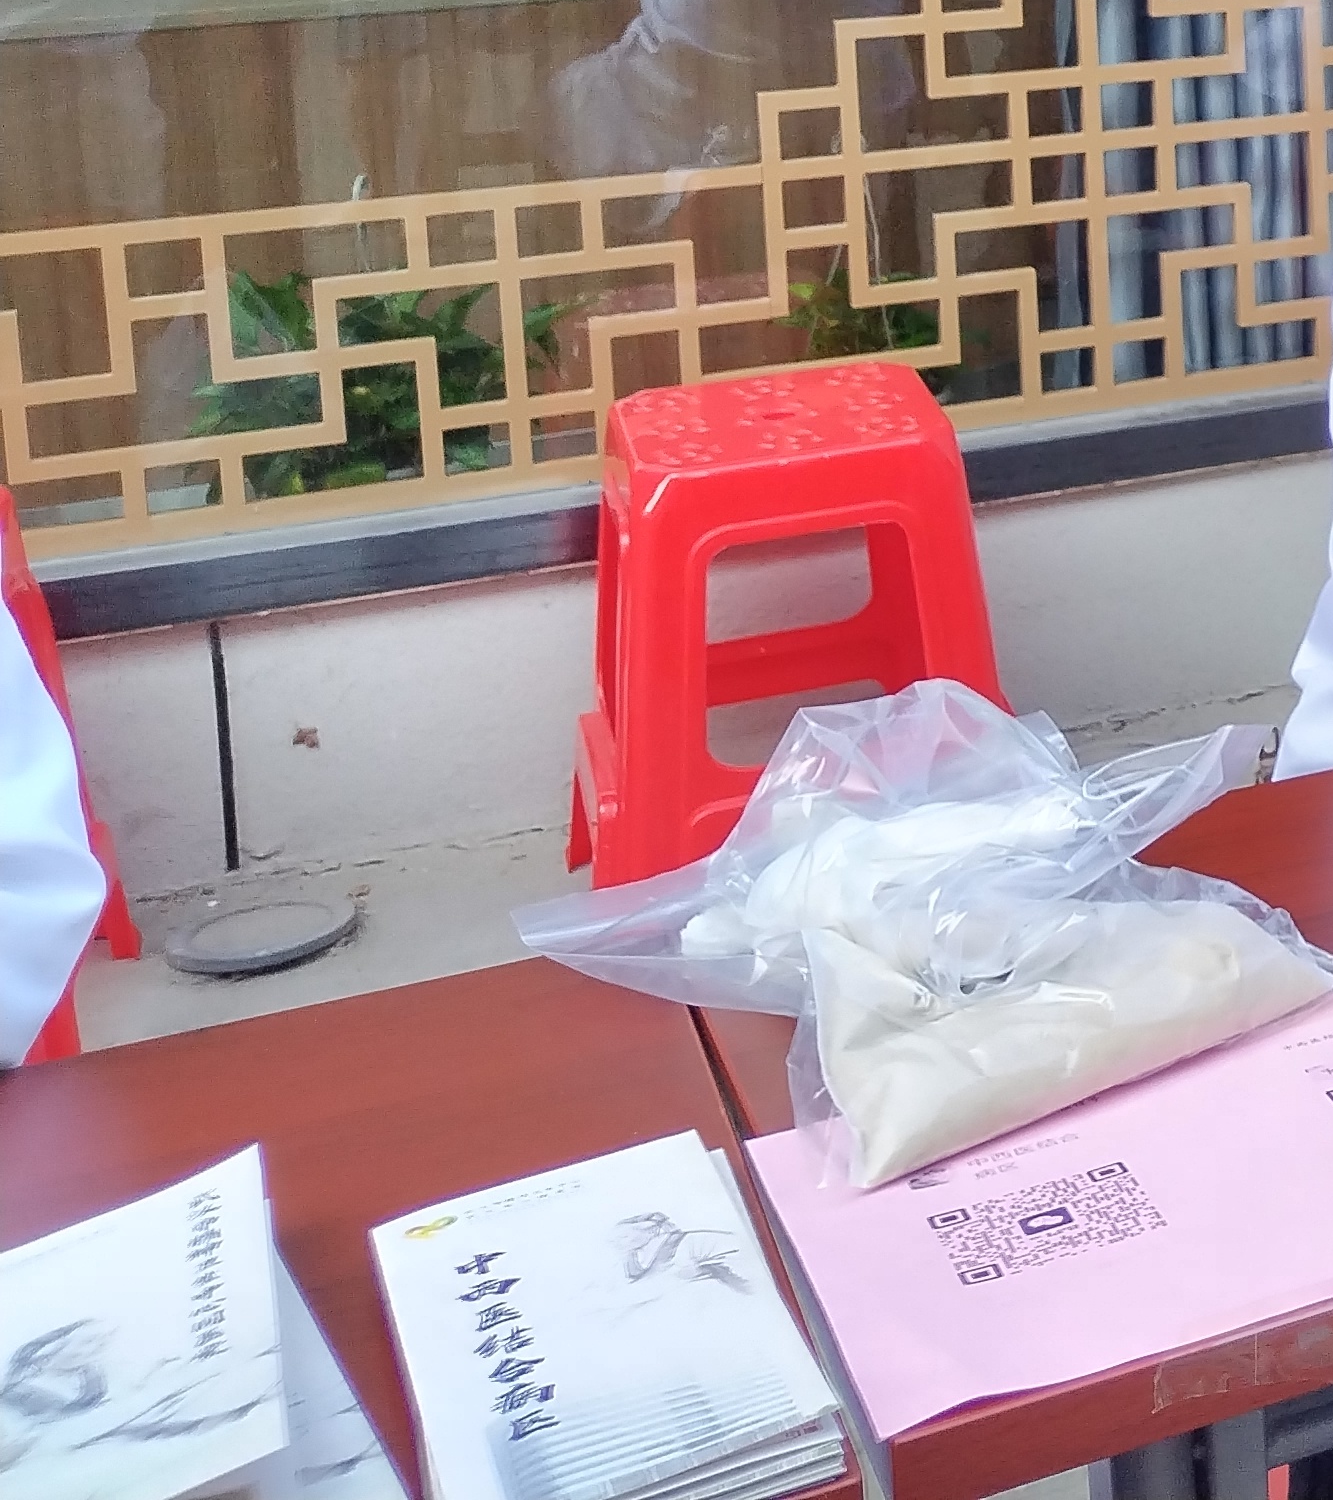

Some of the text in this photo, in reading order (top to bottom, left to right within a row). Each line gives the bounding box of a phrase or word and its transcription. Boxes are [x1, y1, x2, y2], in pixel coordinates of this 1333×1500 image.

[453, 1250, 562, 1441] 中西医结合病区
